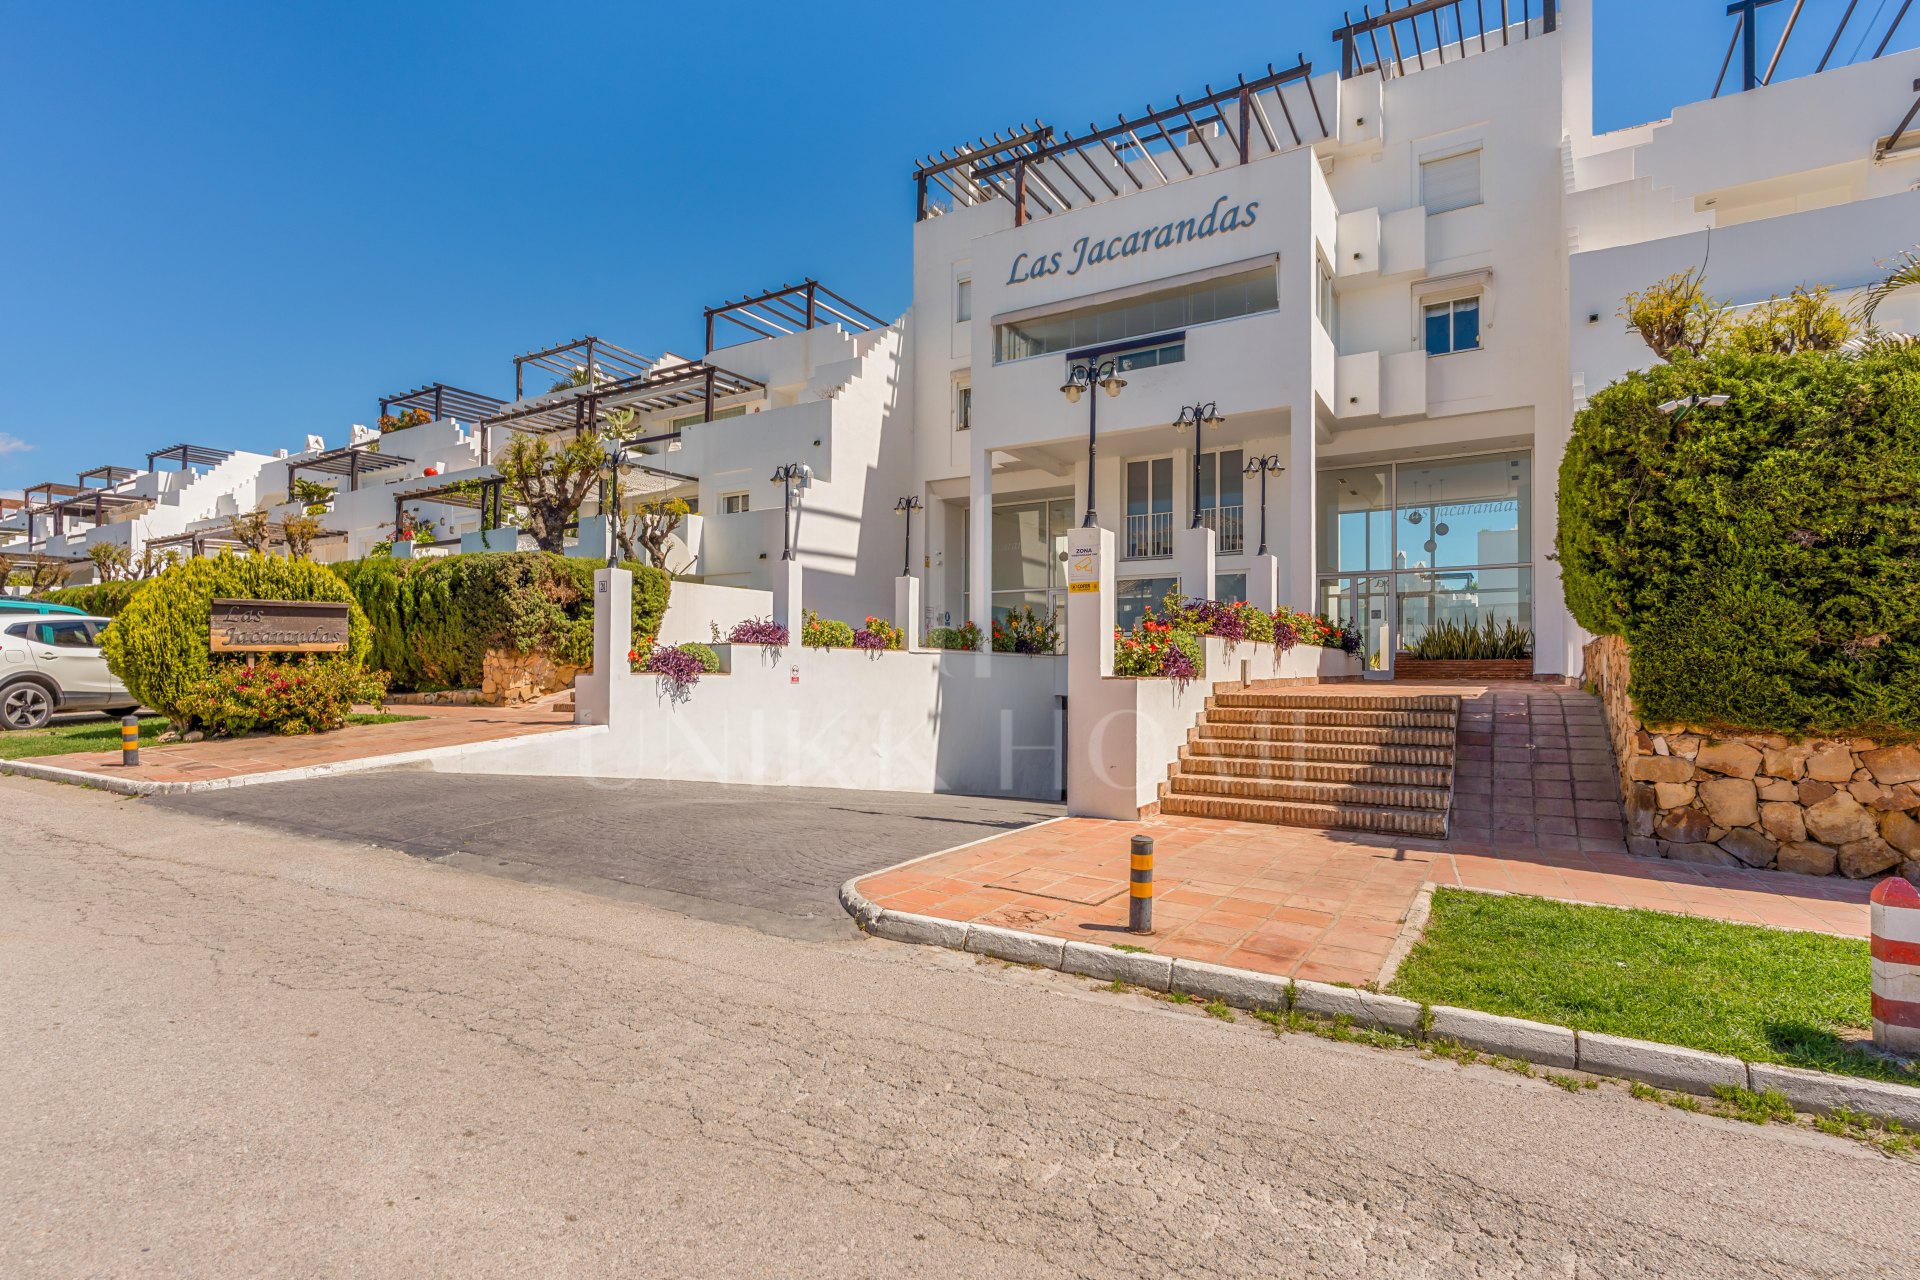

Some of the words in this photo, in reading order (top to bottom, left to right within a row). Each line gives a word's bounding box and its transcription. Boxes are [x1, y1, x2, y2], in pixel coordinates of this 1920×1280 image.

[1006, 252, 1063, 286] Las
[1066, 195, 1260, 276] Jacarandas
[222, 606, 265, 624] Las
[221, 626, 340, 646] Jacarandas
